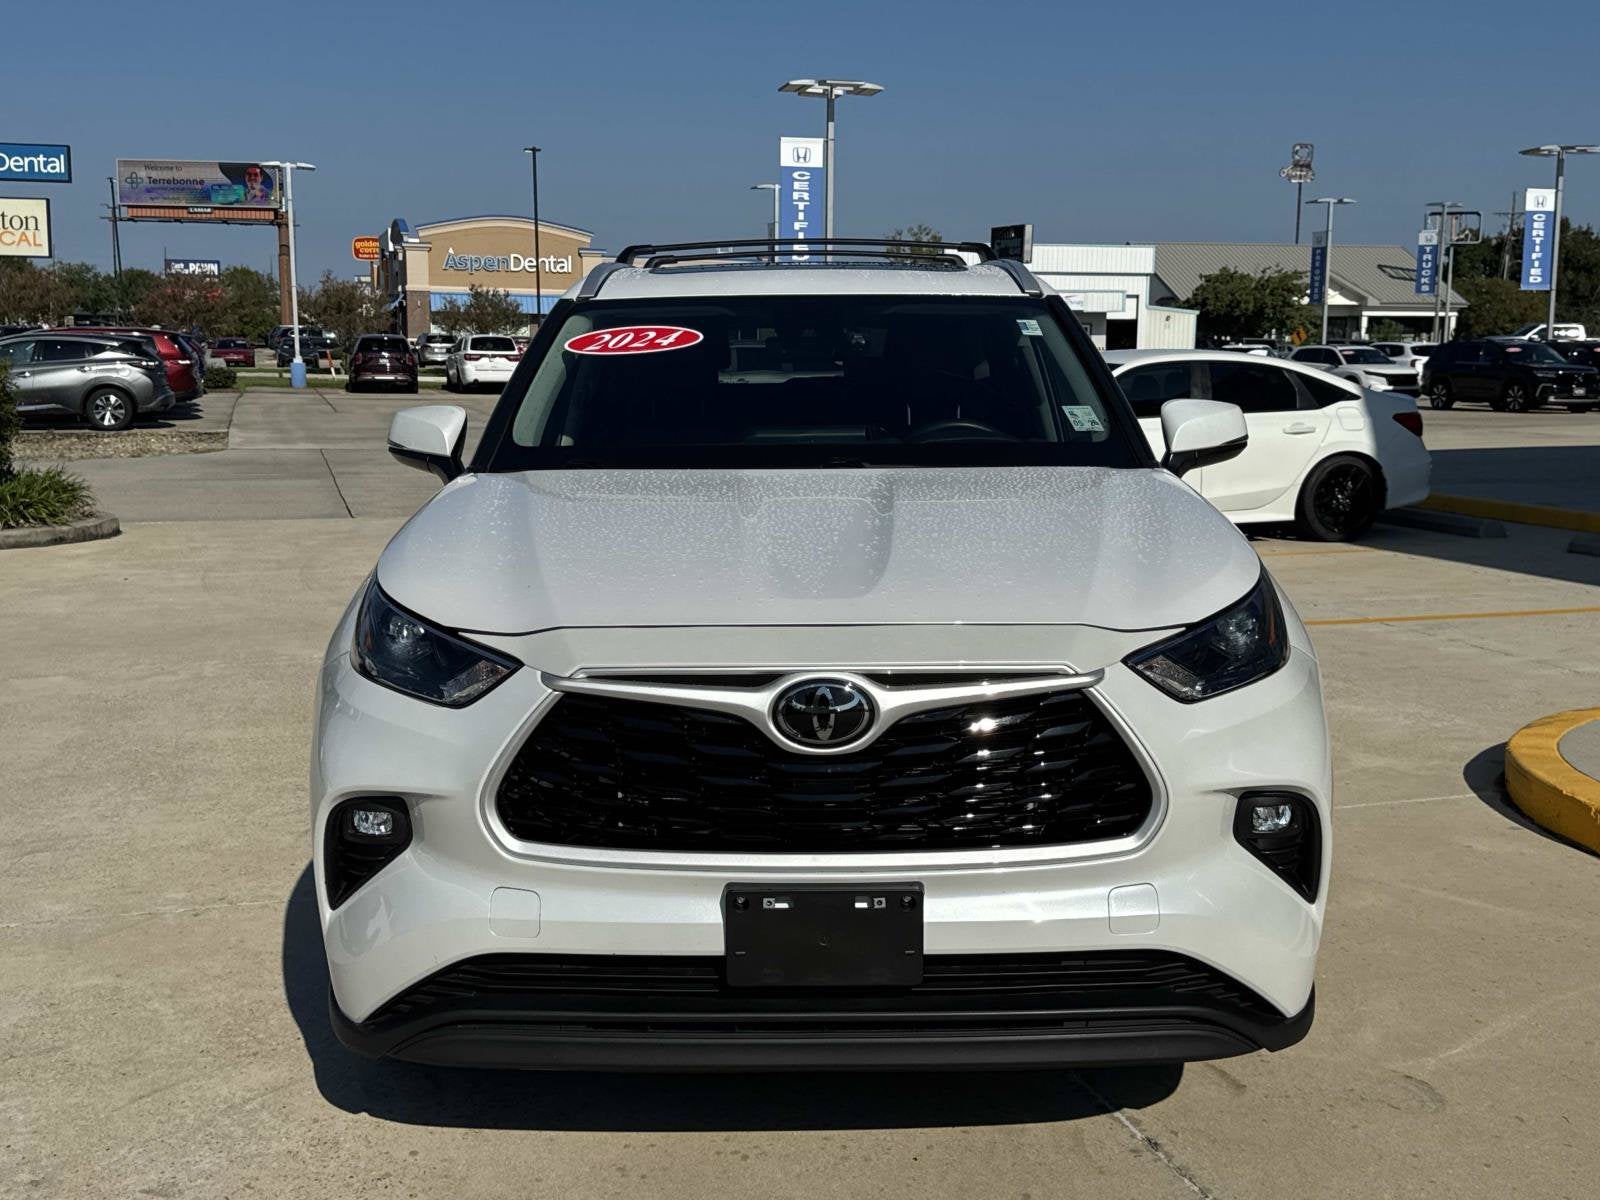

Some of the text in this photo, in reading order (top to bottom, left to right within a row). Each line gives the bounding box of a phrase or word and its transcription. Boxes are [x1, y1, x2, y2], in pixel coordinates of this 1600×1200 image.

[147, 177, 206, 186] Terrebonne
[0, 211, 40, 231] ton
[1529, 213, 1546, 283] CERTIFIED
[1421, 247, 1433, 291] TRUCKS
[582, 330, 685, 351] 2024
